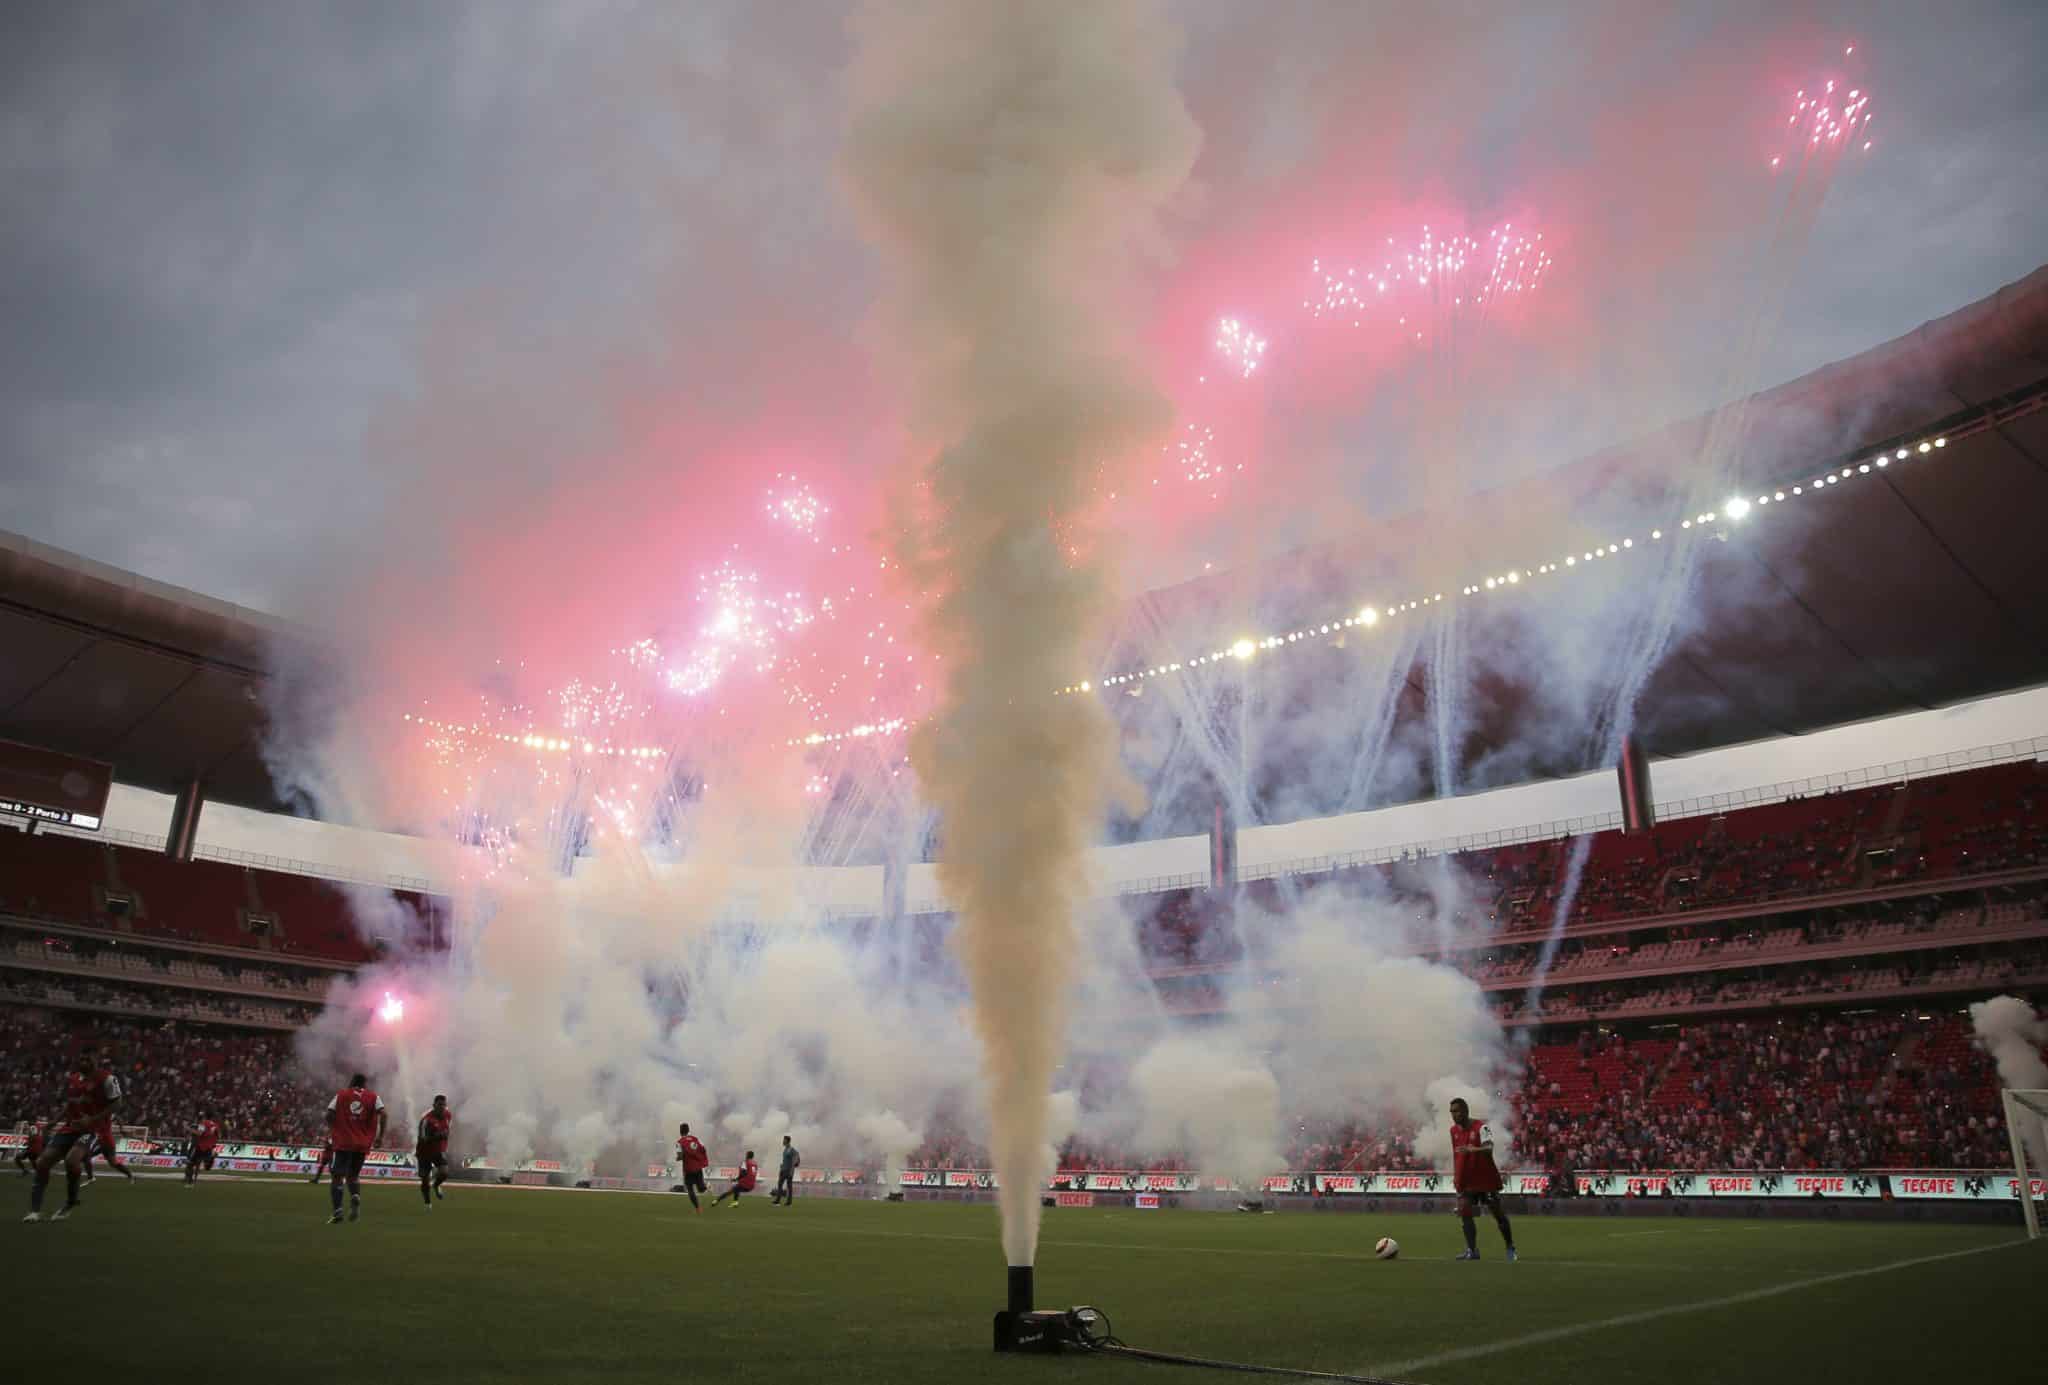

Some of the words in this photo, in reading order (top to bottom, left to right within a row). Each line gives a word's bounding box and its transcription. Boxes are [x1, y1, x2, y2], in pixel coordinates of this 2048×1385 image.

[36, 808, 60, 819] Porto
[1707, 1178, 1752, 1191] TECATE
[1795, 1178, 1844, 1192] TECATE
[1902, 1179, 1955, 1193] TECATE
